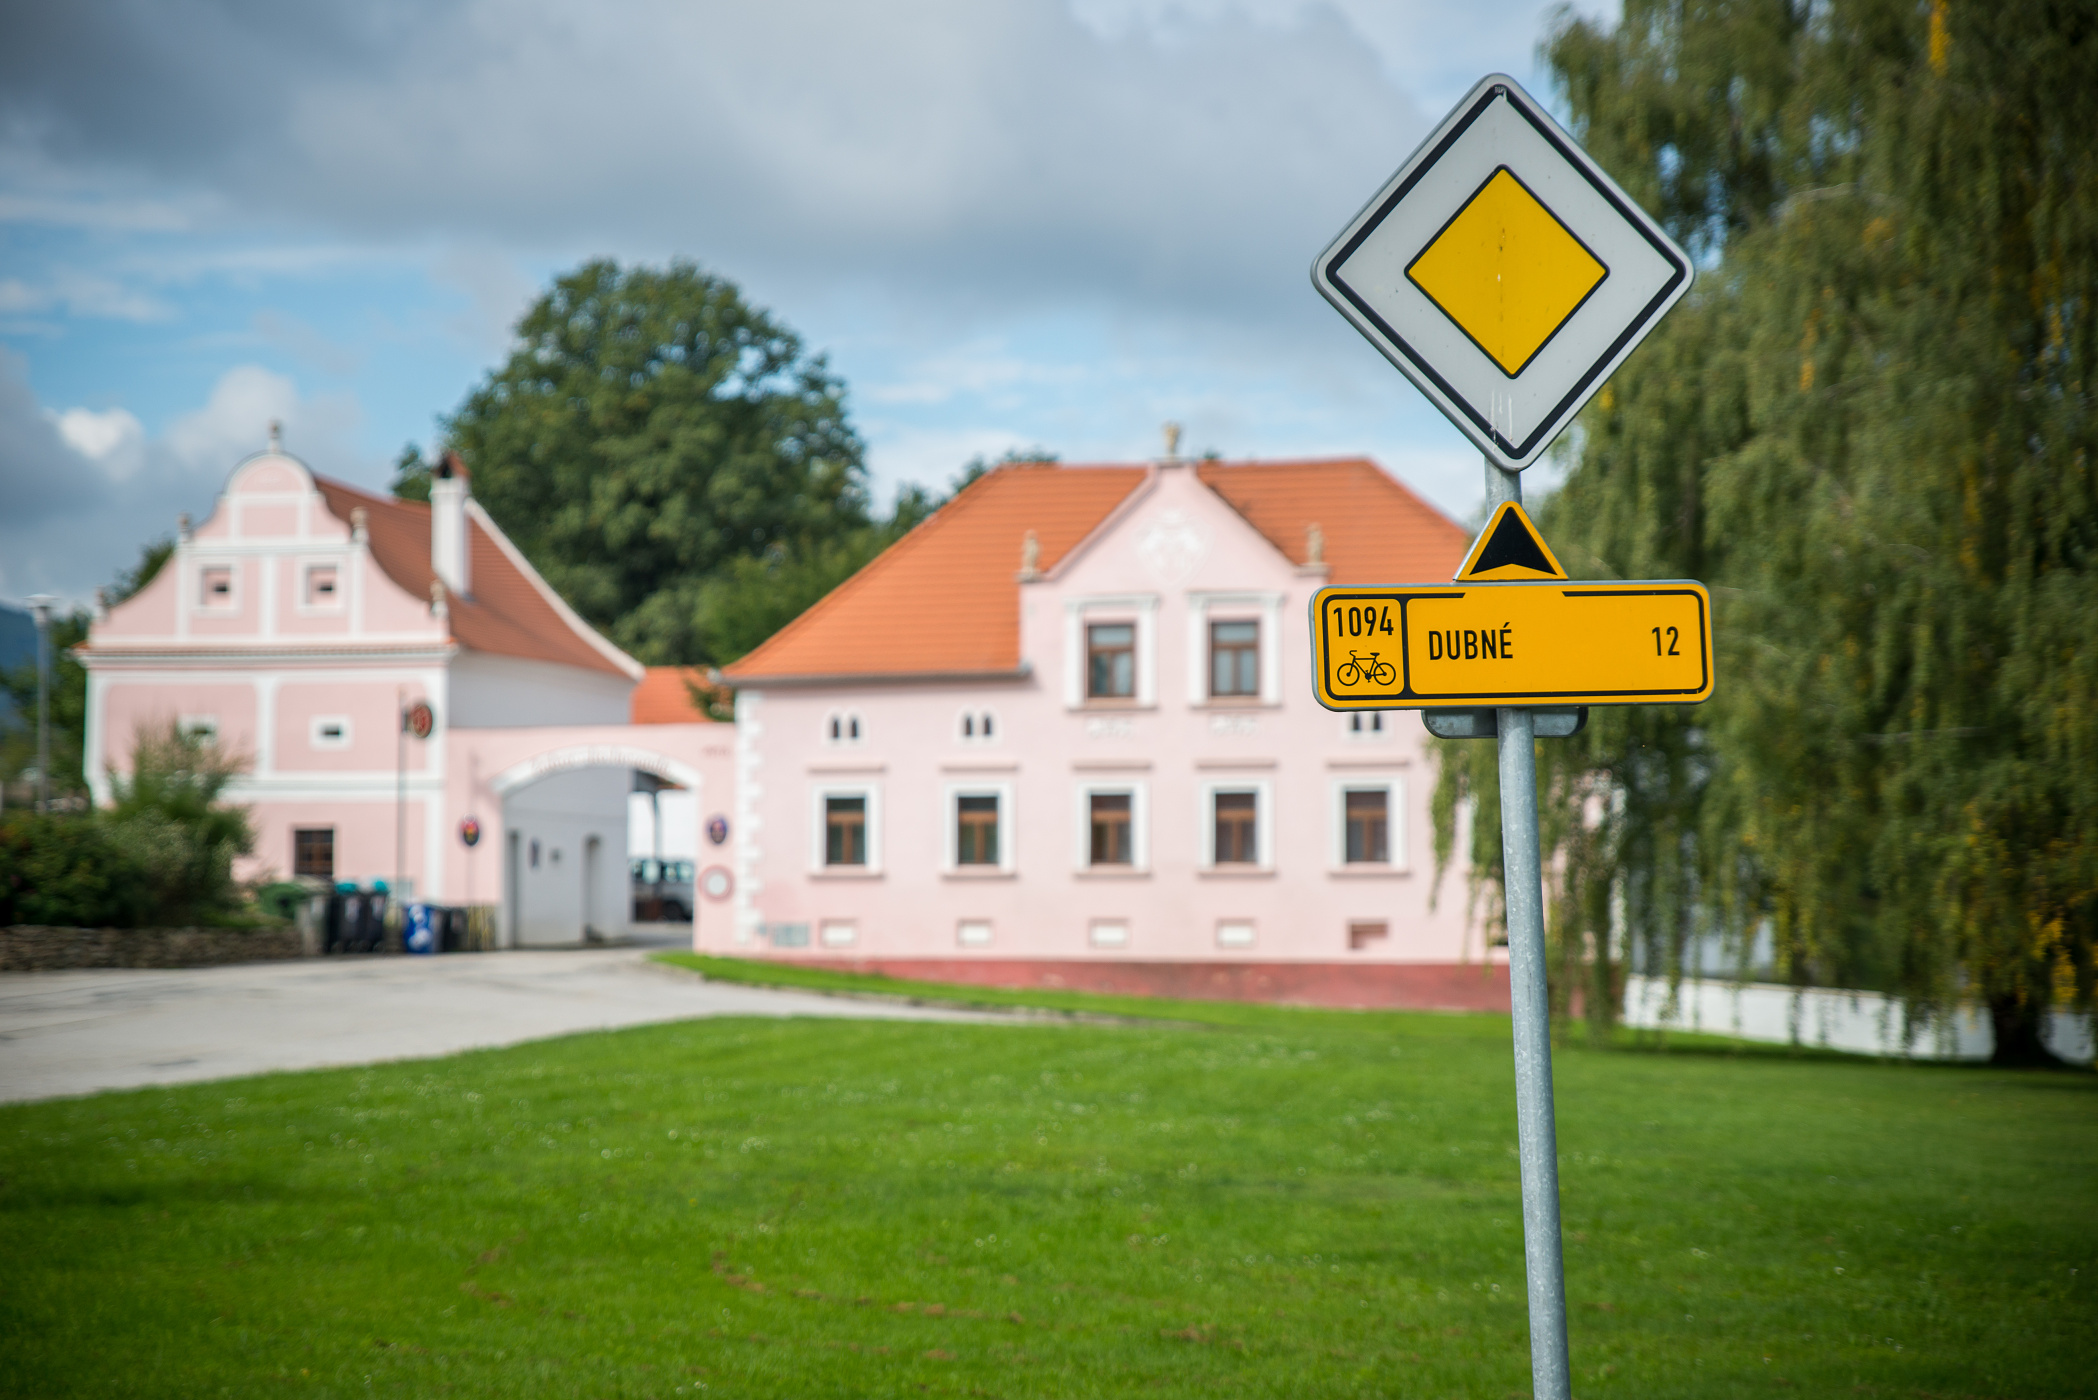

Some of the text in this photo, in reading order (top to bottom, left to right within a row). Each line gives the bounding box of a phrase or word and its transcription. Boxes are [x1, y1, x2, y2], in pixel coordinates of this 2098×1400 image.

[1333, 606, 1394, 637] 1094
[1428, 622, 1680, 660] DUBNÉ 12
